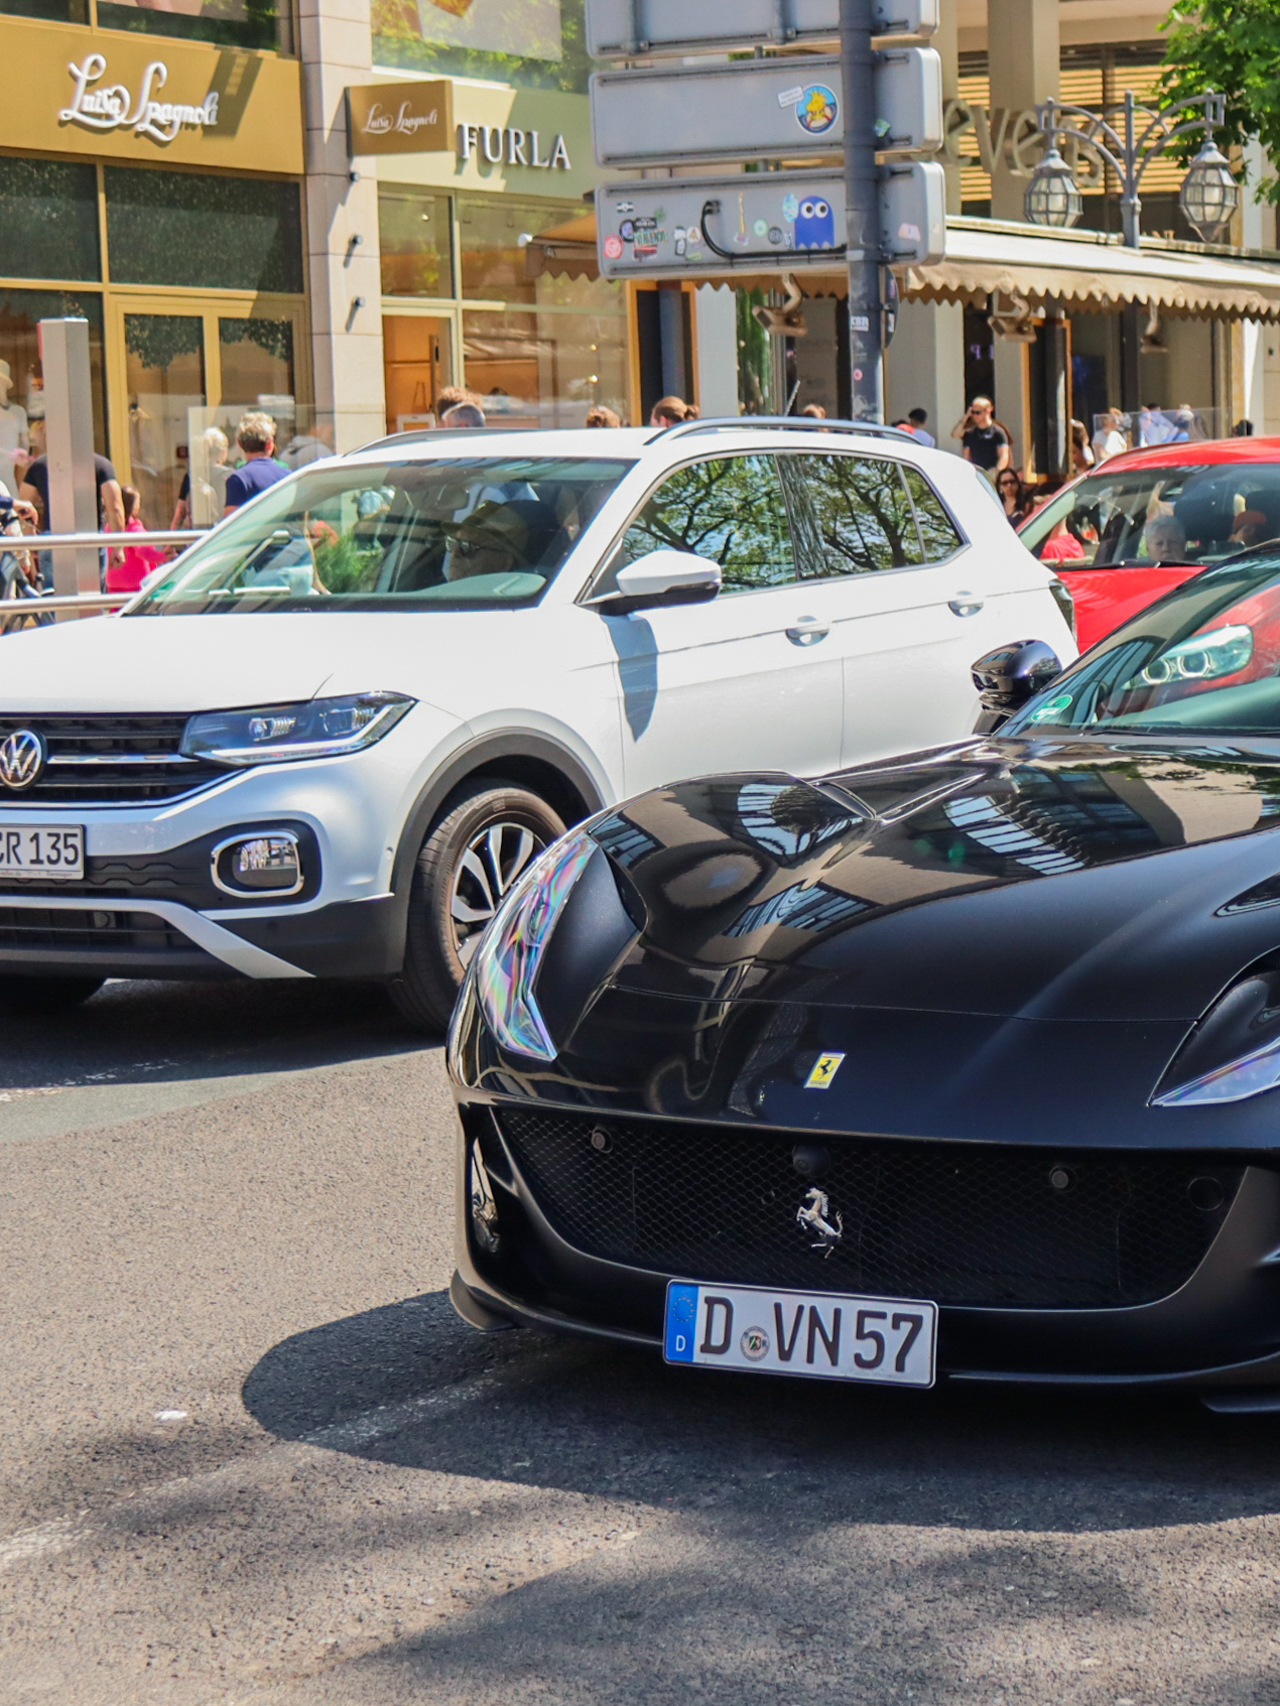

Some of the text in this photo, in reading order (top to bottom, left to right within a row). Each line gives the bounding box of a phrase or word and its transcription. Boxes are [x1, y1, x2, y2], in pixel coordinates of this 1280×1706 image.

[58, 53, 220, 142] Luisa Spagnoli
[361, 101, 438, 136] Luisa Spagnoli
[461, 122, 572, 170] FURLA
[29, 832, 79, 866] 135
[675, 1335, 686, 1352] D
[700, 1295, 735, 1355] D
[773, 1302, 842, 1367] VN
[853, 1309, 924, 1373] 57
